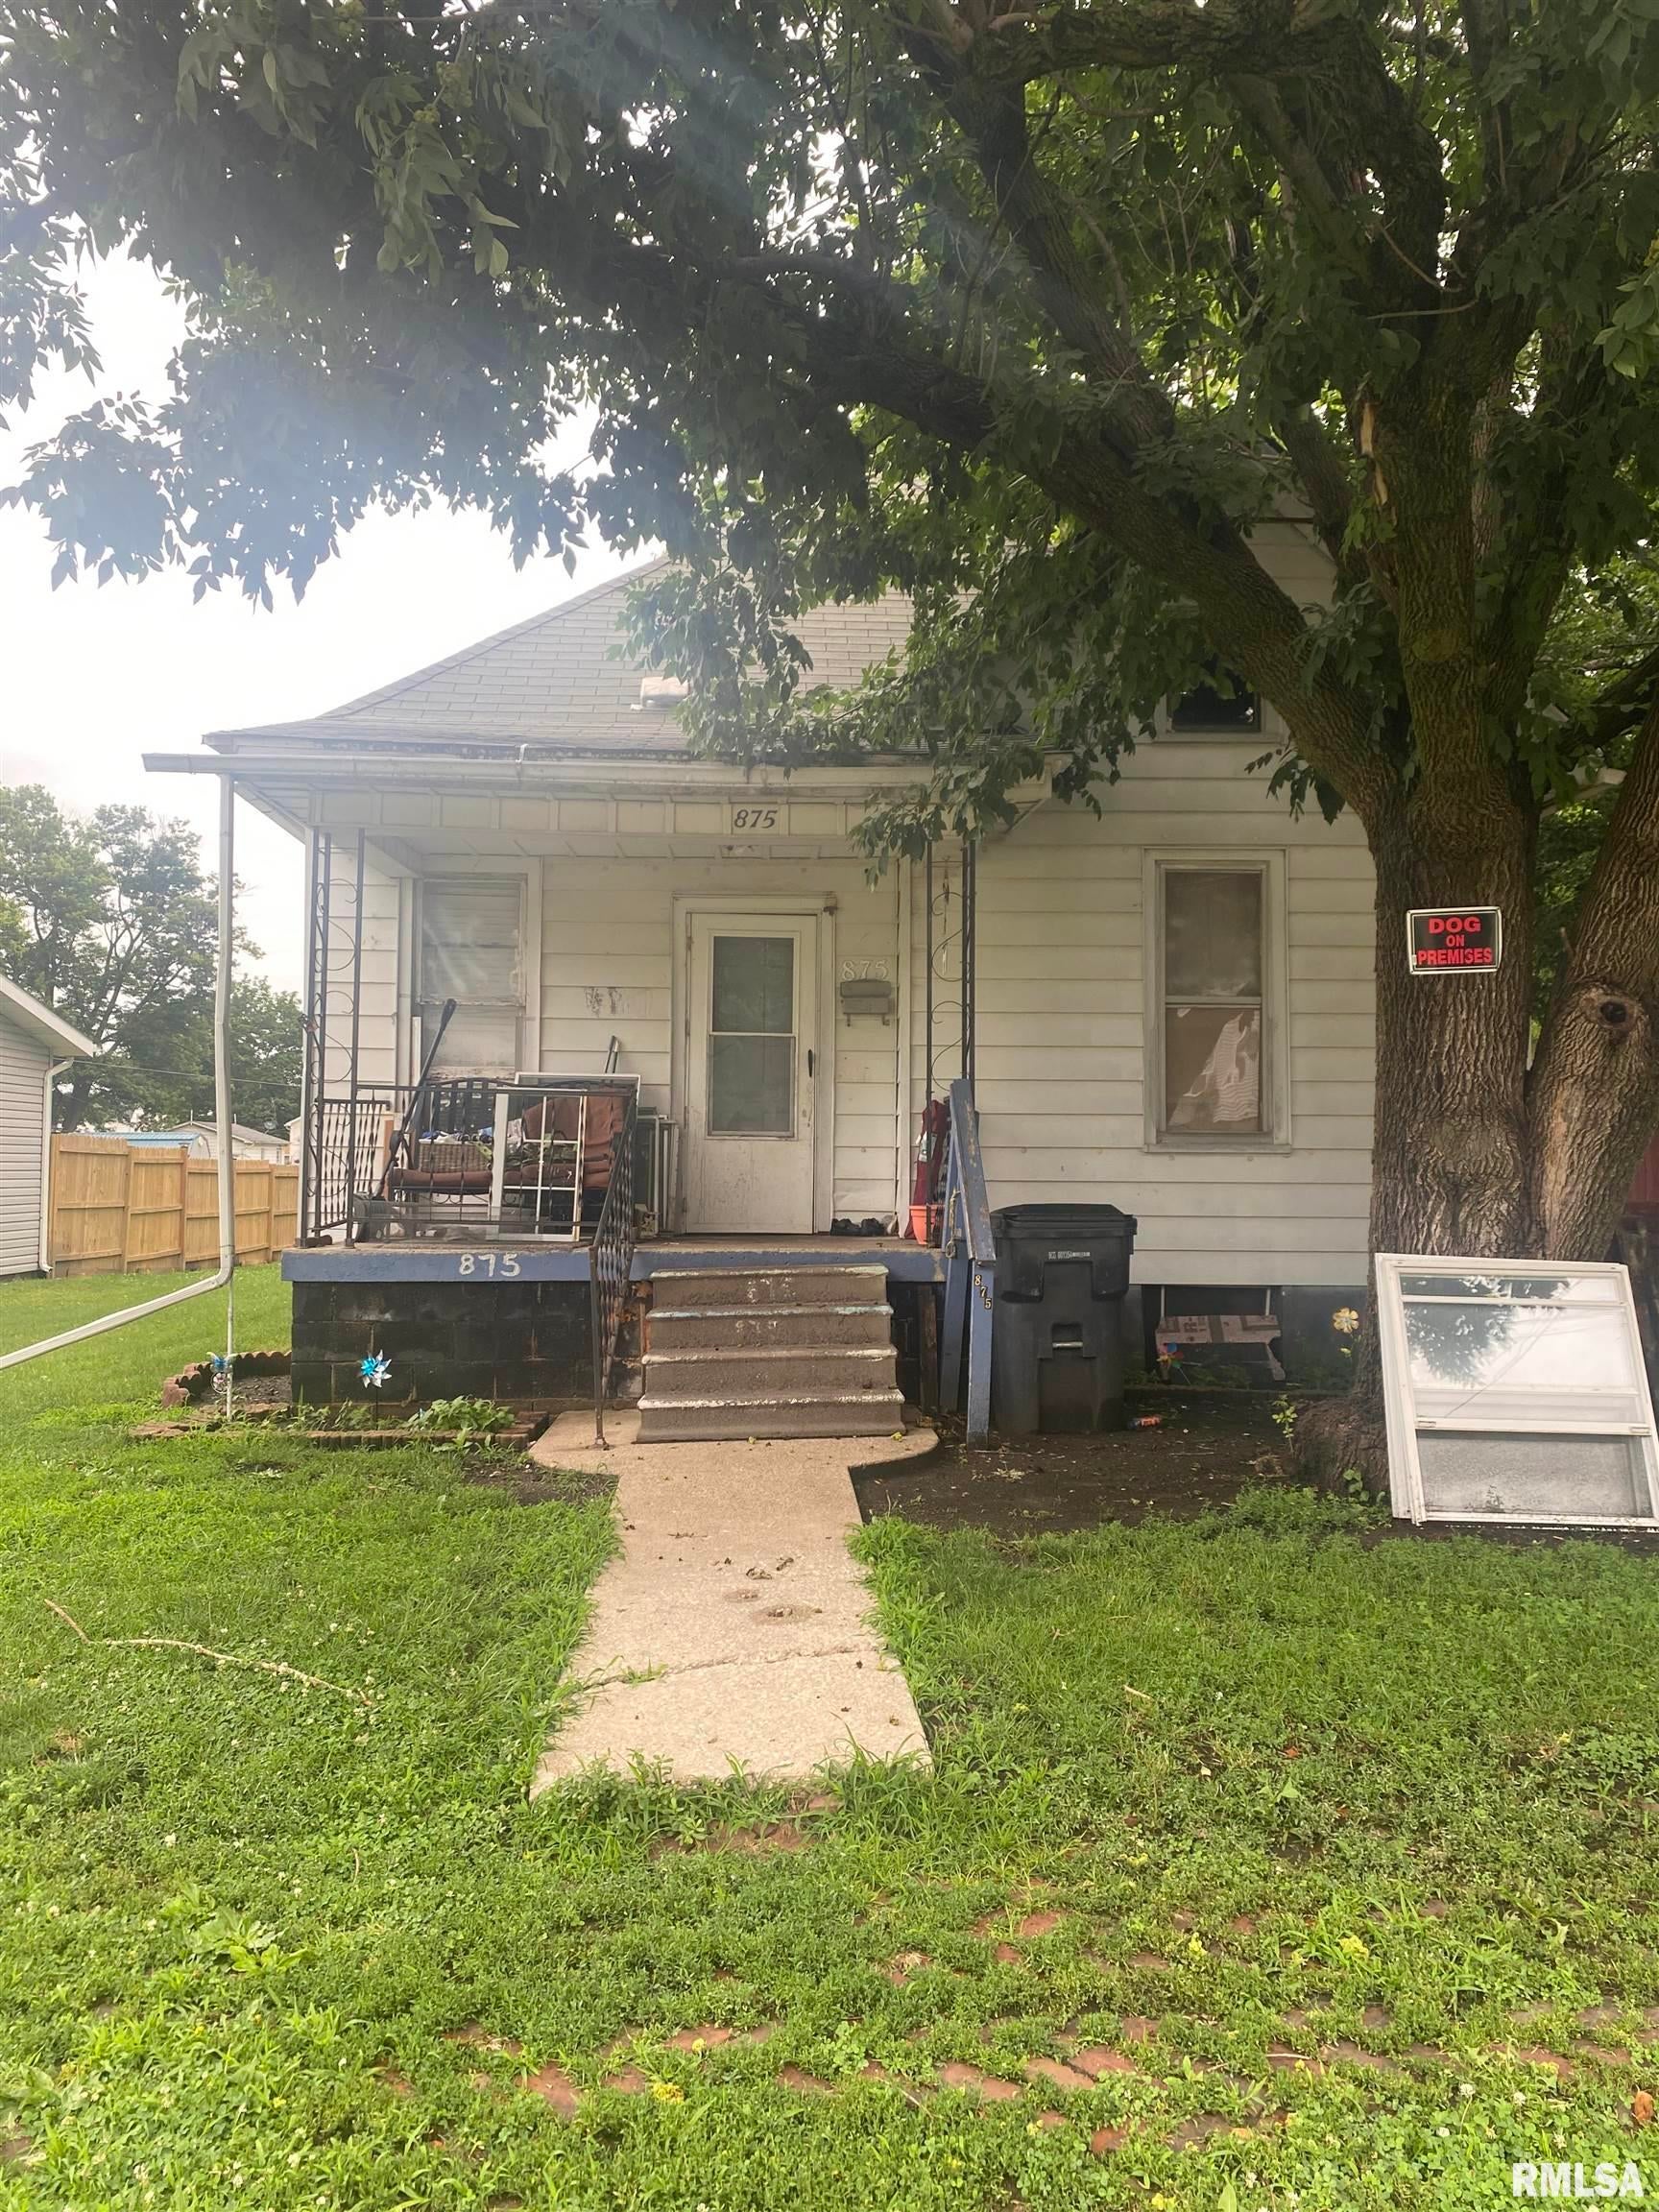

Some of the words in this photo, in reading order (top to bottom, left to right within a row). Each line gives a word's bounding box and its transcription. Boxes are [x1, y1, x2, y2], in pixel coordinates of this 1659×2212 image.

[734, 809, 778, 829] 875
[1429, 916, 1480, 933] DOG
[1446, 934, 1465, 947] ON
[1417, 948, 1492, 965] PREMISES
[842, 960, 888, 980] 875
[459, 1253, 521, 1277] 875
